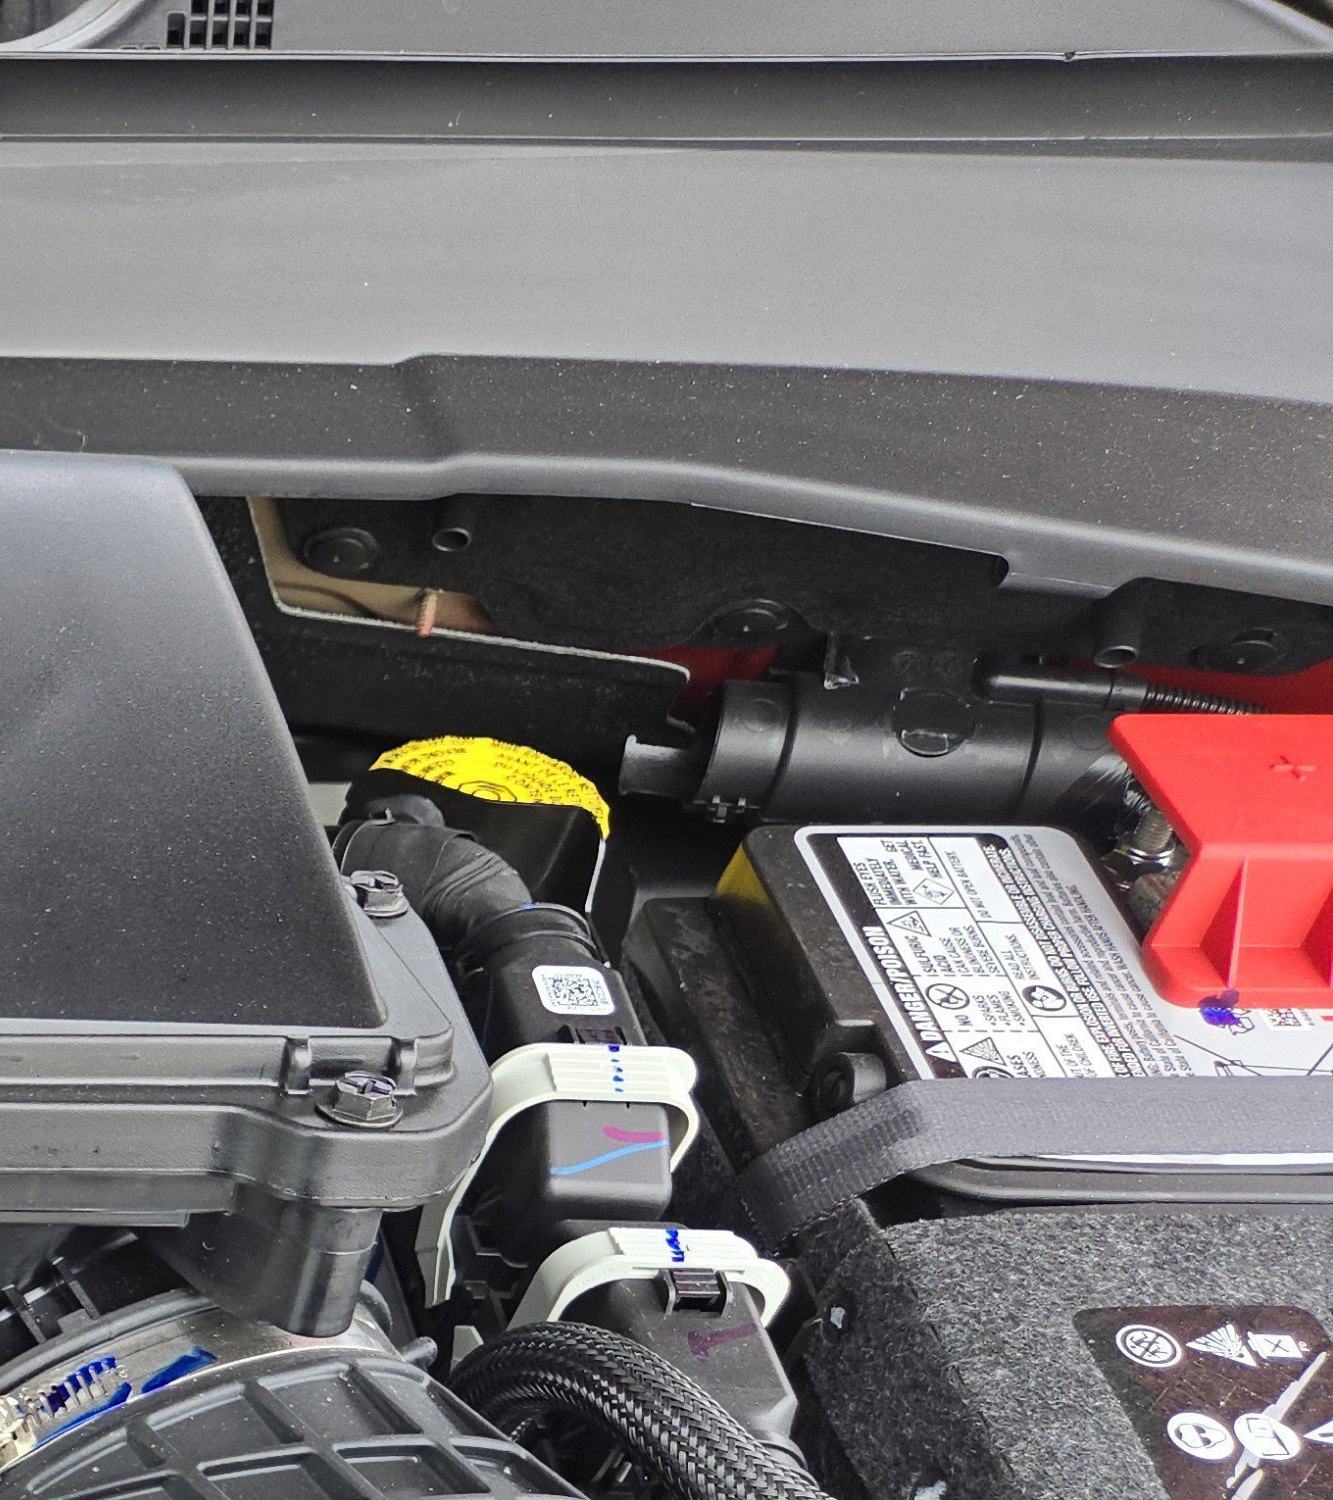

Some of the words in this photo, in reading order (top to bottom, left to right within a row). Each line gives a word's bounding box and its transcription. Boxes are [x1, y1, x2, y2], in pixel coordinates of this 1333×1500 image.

[852, 862, 874, 879] EYES
[864, 858, 903, 904] IMMEDIATELY
[902, 935, 938, 972] SULFURIC
[937, 936, 961, 957] CAUSE
[931, 955, 955, 972] ACID
[859, 926, 945, 1040] DANGER/POISON
[953, 1014, 973, 1026] NO
